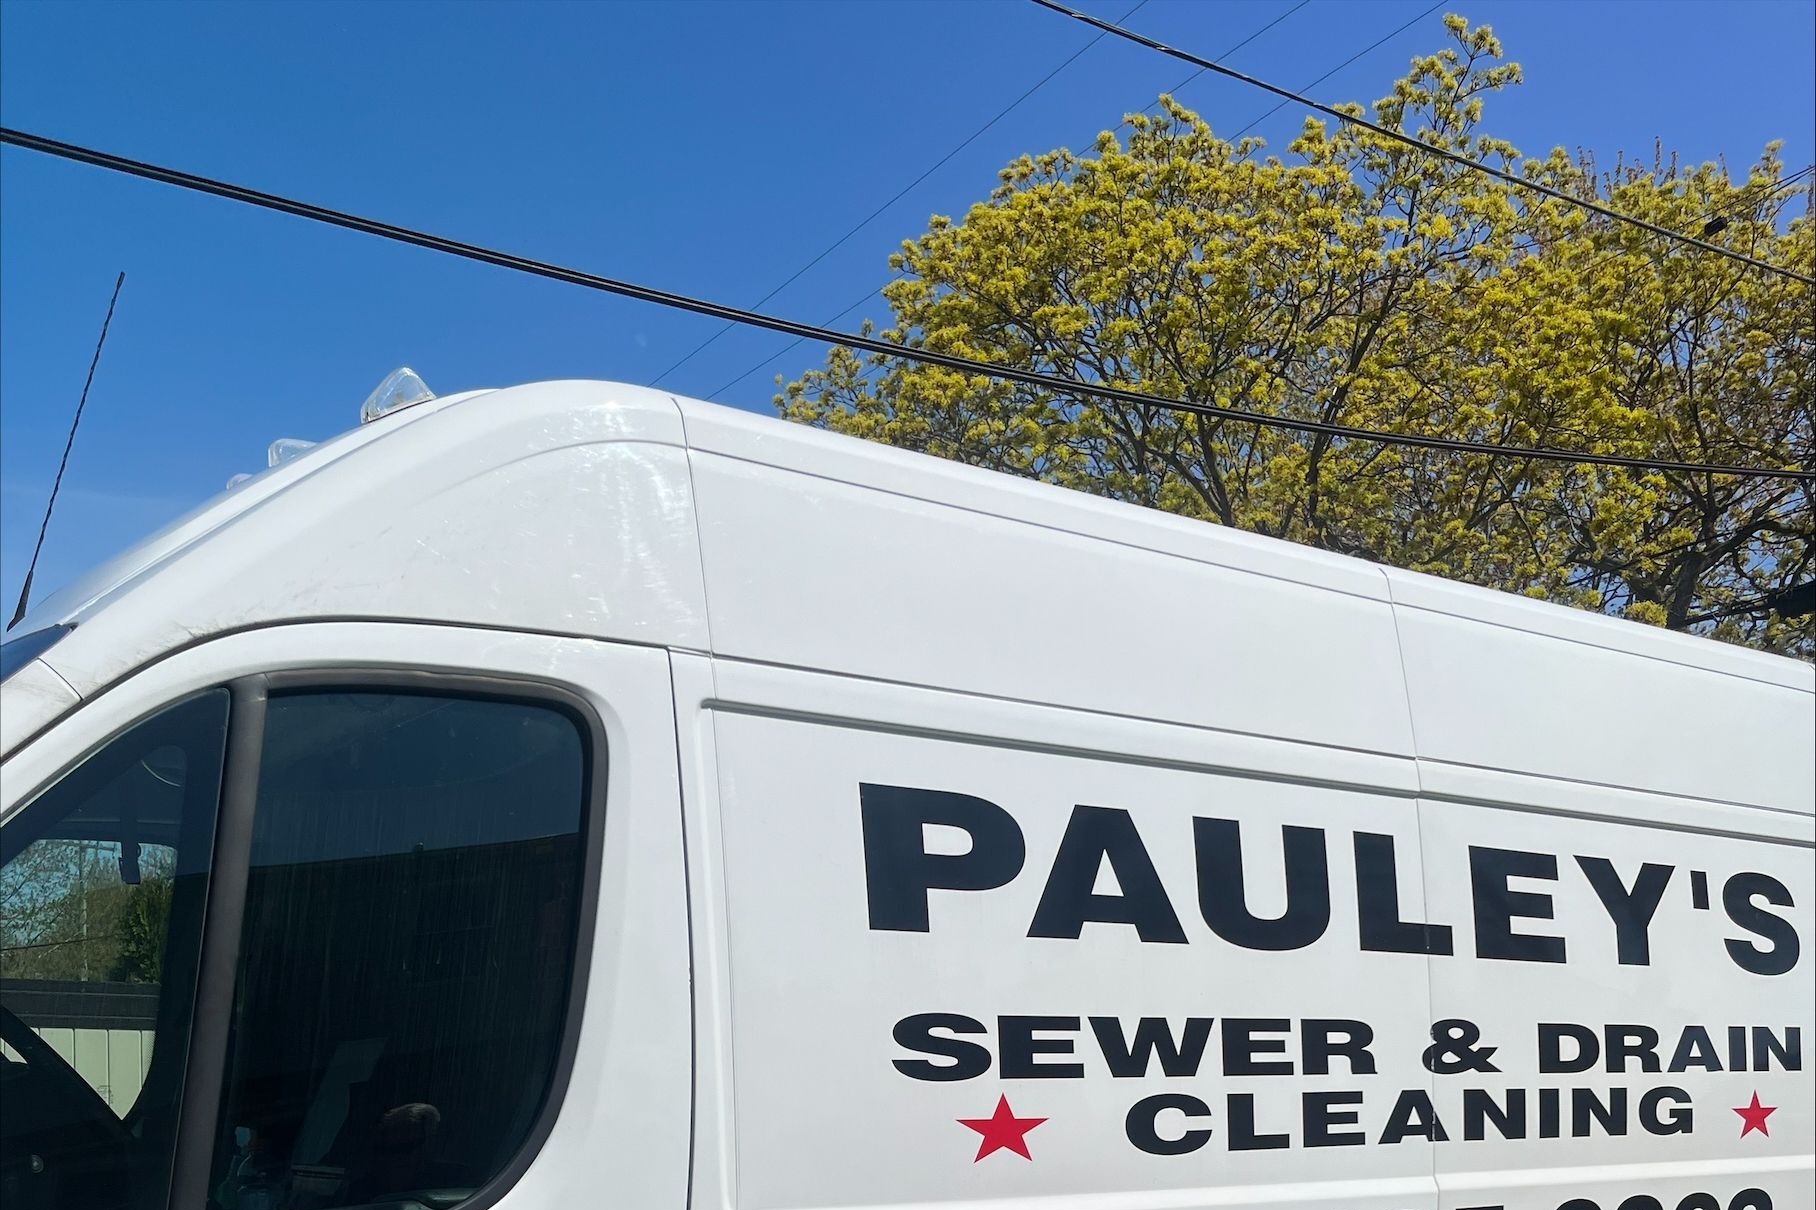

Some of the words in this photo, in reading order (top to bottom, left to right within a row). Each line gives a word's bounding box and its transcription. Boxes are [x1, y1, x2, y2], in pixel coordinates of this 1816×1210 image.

[859, 782, 1801, 976] PAULEY'S
[890, 1010, 1378, 1084] SEWER
[1420, 1016, 1500, 1078] &
[1536, 1021, 1803, 1073] DRAIN
[1125, 1086, 1695, 1156] CLEANING
